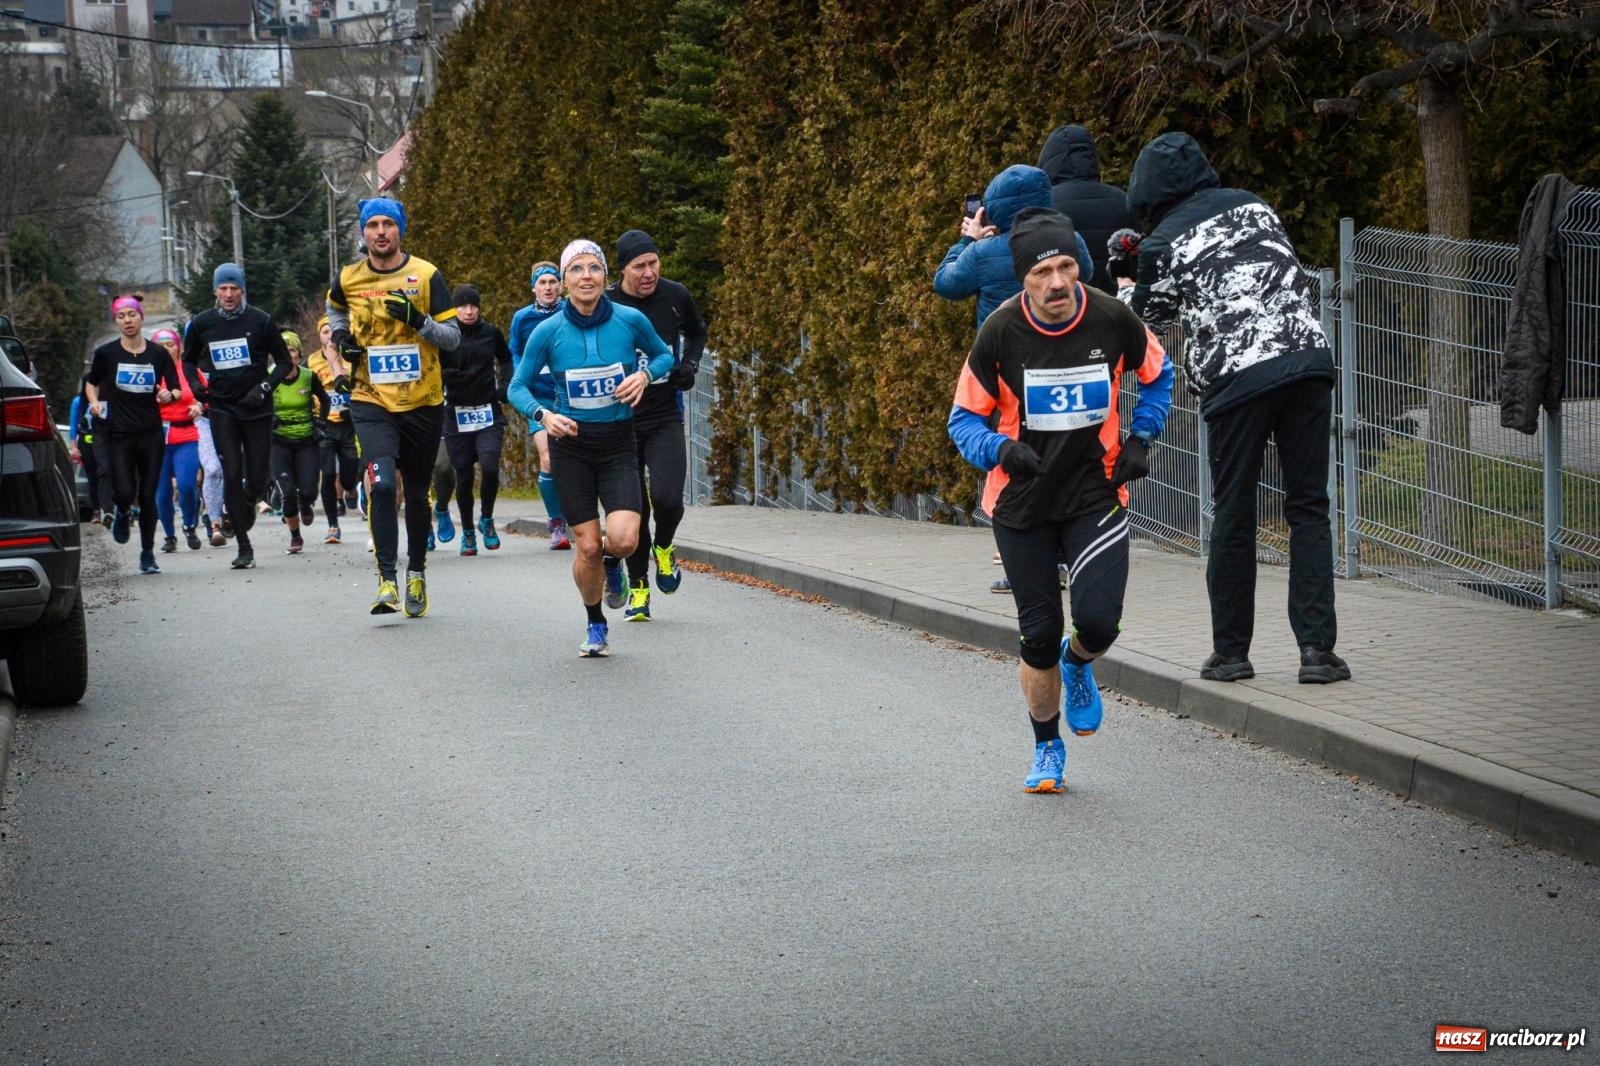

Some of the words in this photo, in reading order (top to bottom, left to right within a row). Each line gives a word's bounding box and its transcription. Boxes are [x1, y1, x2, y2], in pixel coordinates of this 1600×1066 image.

[217, 346, 243, 361] 188
[378, 355, 412, 372] 113
[128, 372, 146, 385] 76
[578, 377, 617, 397] 118
[1050, 384, 1088, 412] 31
[463, 411, 487, 424] 133
